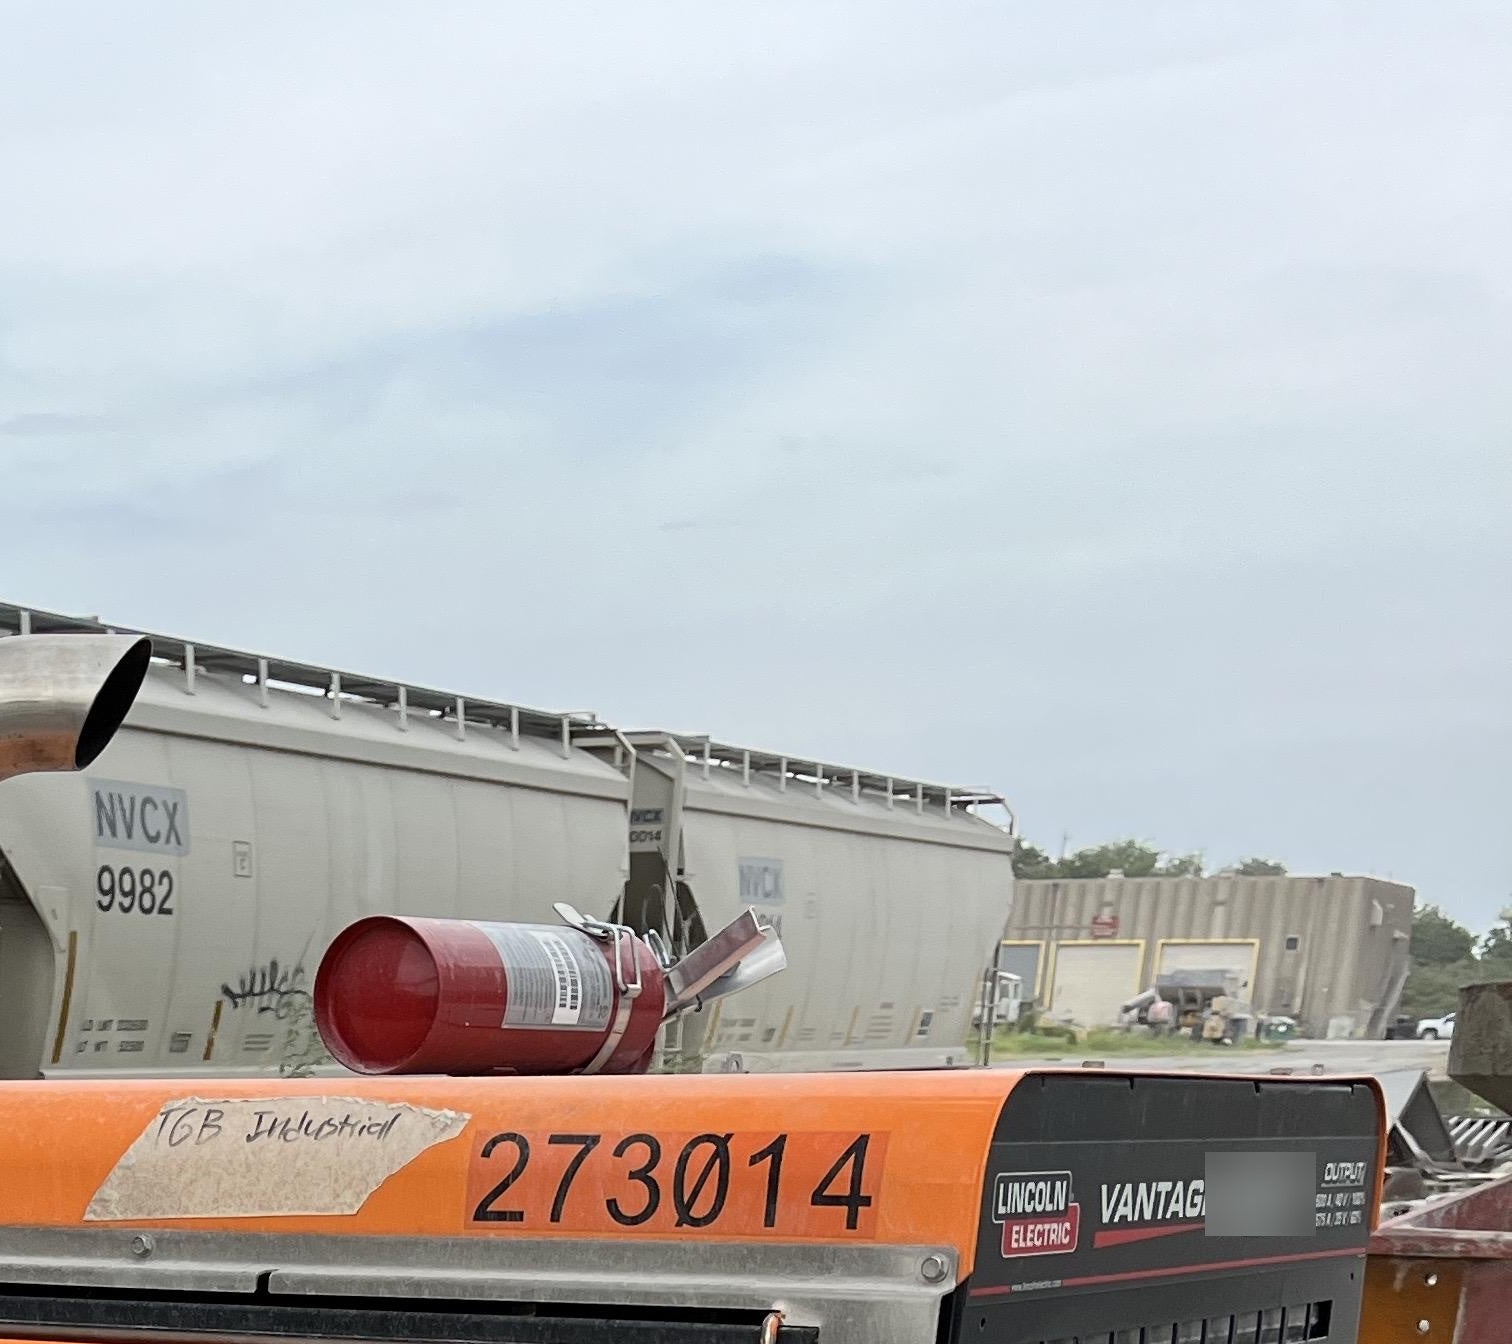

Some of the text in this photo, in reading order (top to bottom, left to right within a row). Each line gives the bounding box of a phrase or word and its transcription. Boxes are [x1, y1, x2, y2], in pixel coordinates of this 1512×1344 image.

[94, 790, 183, 846] NVCX
[96, 864, 174, 915] 9982
[245, 1110, 402, 1143] Industrial
[997, 1180, 1068, 1215] LINCOLN
[1100, 1179, 1206, 1224] VANTAG
[1010, 1222, 1071, 1249] ELECTRIC
